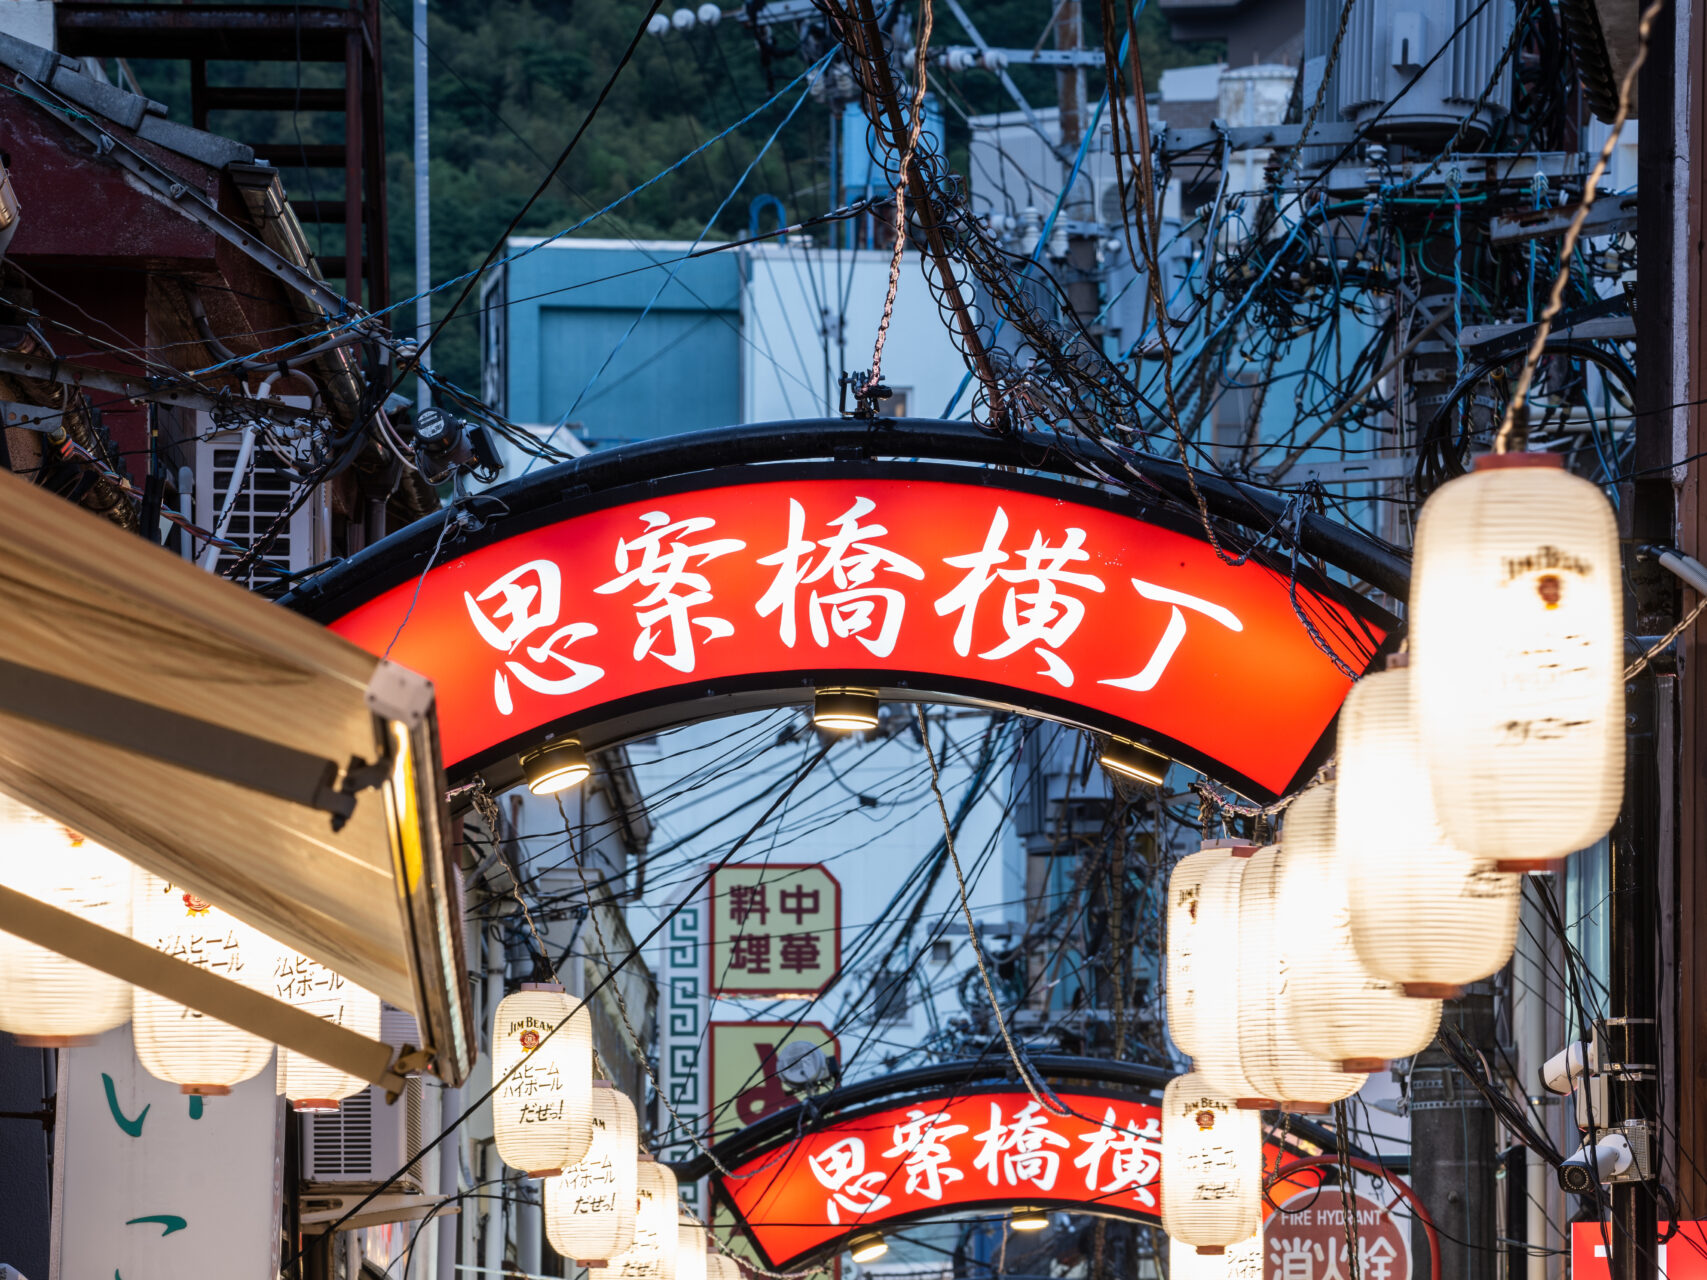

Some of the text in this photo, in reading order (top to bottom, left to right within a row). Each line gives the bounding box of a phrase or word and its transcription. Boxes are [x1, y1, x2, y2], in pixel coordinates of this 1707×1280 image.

[464, 496, 1243, 716] 思案橋横丁
[729, 884, 771, 974] 料理
[779, 884, 820, 974] 中華
[508, 1016, 554, 1036] JIM BEAM
[808, 1100, 1161, 1226] 思案橋横
[1280, 1209, 1383, 1227] FIRE HYDRANT
